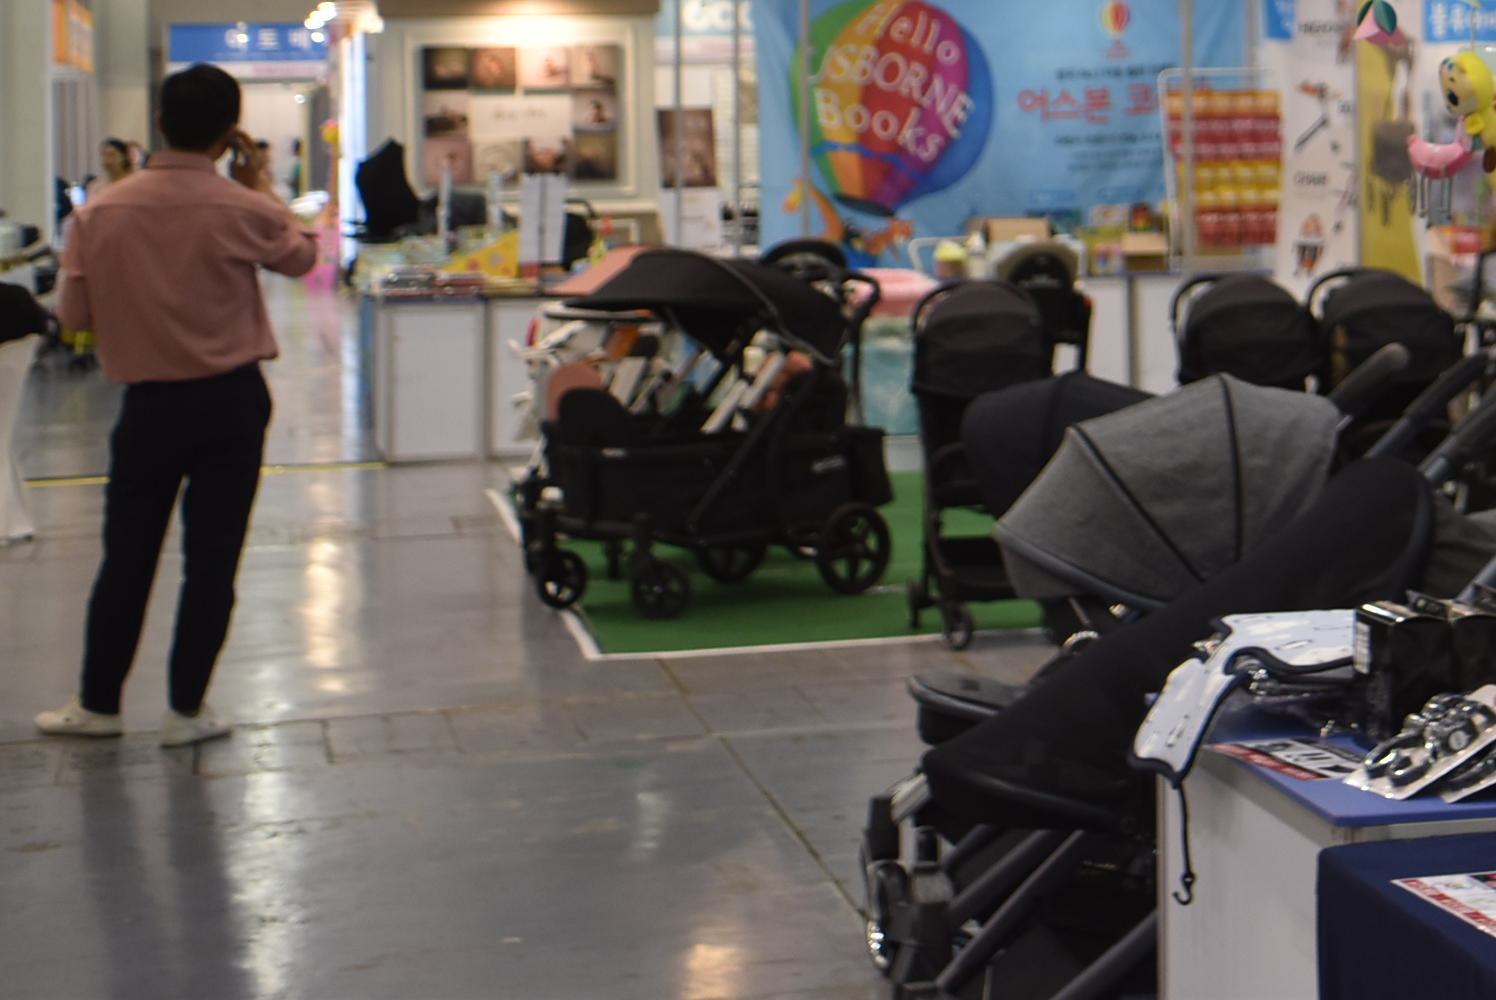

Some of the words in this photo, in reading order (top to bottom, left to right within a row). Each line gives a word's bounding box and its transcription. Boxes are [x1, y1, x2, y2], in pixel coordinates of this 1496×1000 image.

[855, 2, 961, 65] Hello
[814, 88, 945, 162] Books
[1016, 86, 1113, 124] 어스본
